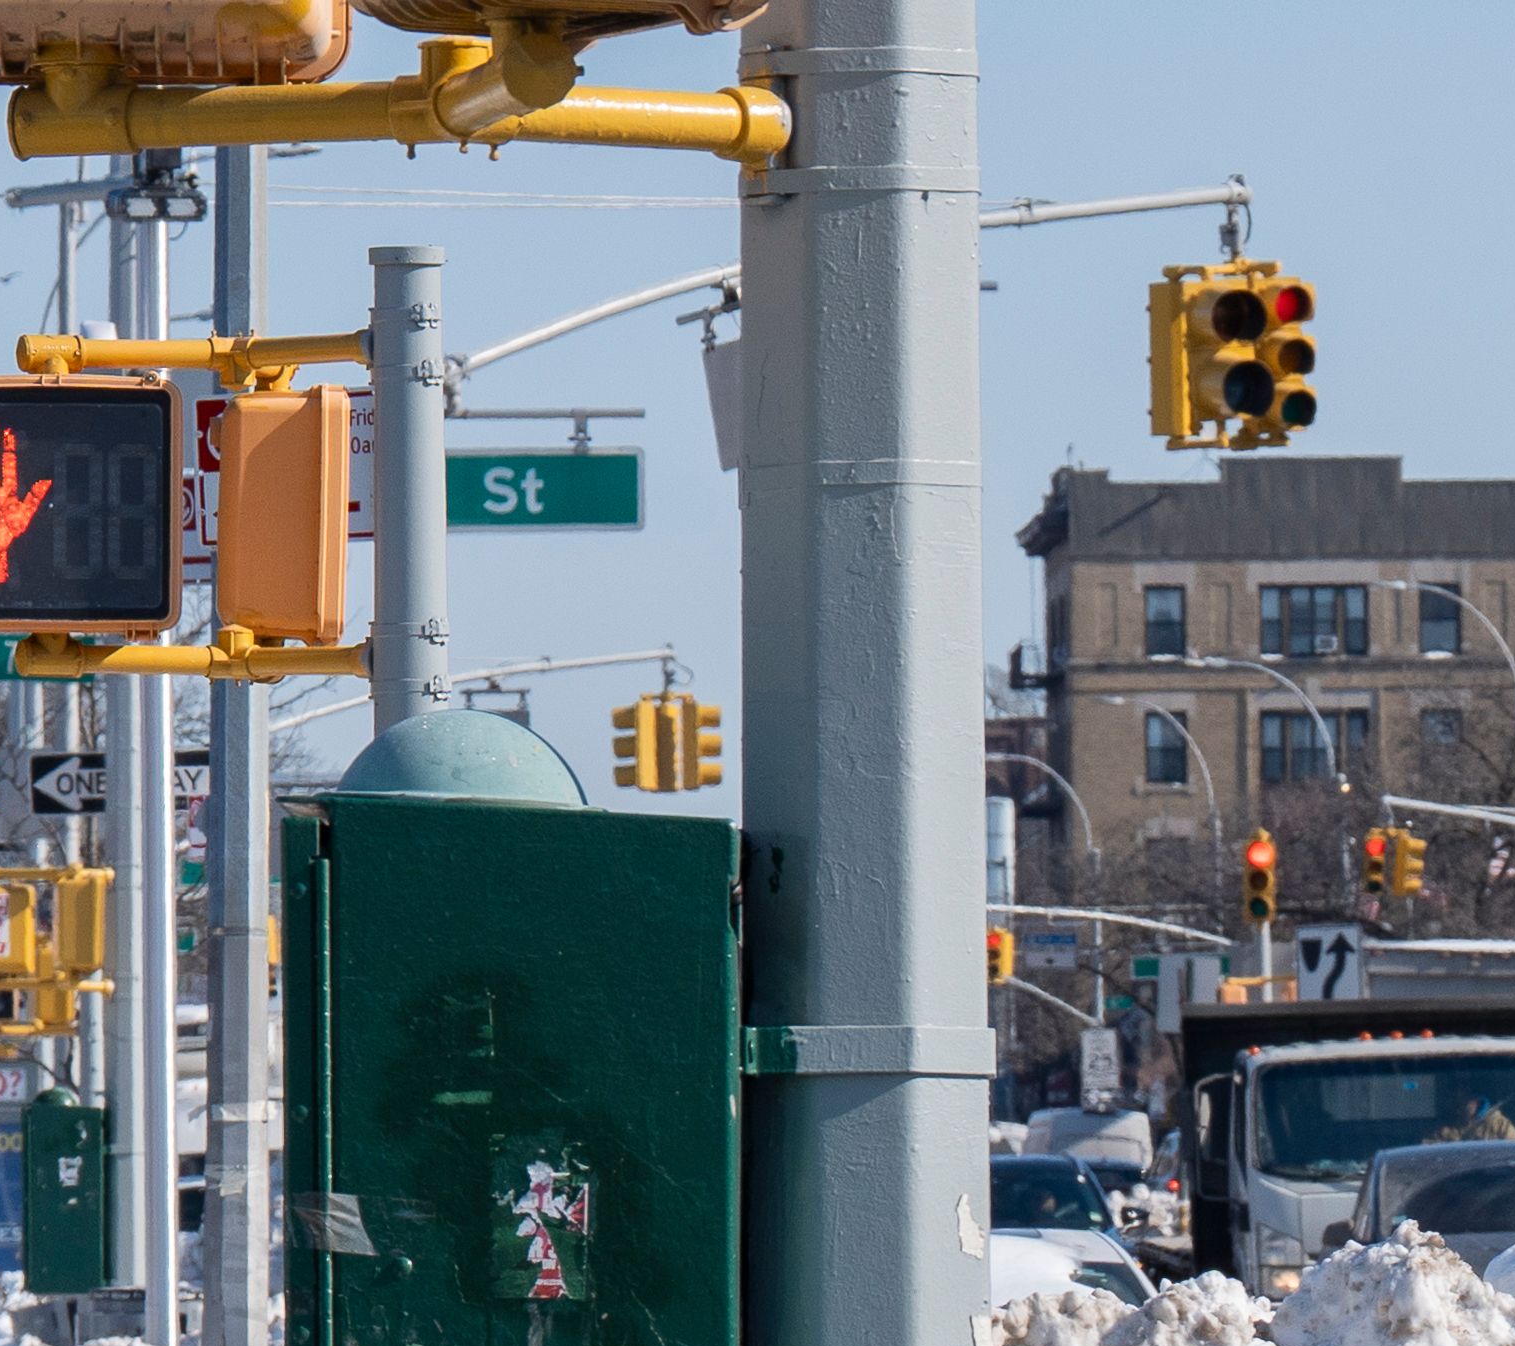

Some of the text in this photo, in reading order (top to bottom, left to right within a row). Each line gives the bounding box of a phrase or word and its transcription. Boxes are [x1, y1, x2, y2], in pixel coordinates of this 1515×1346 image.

[482, 465, 545, 515] St
[55, 769, 203, 796] ONE AY
